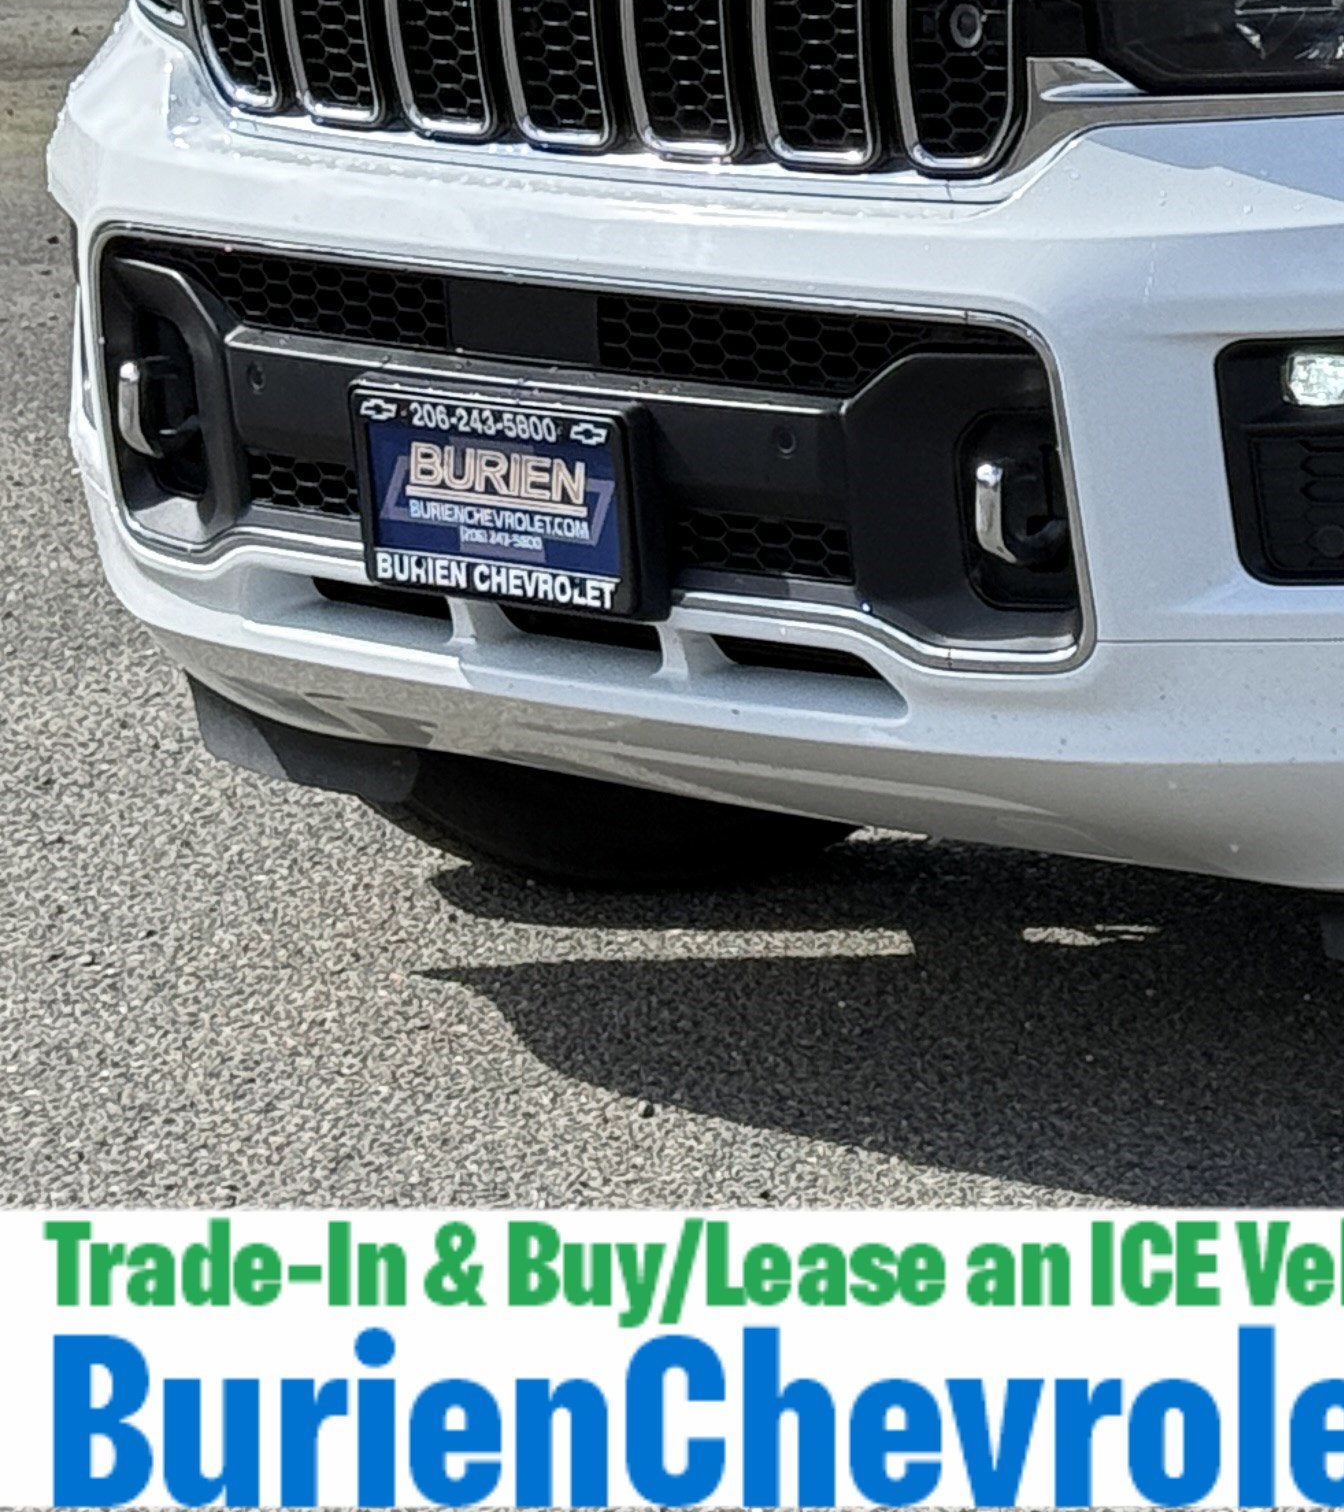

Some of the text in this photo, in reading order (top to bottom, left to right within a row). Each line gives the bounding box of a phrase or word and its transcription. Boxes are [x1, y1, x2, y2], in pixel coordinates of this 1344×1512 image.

[409, 401, 558, 443] 206-243-5800
[409, 440, 586, 506] BURIEN
[408, 498, 590, 541] BURIENCHEVROLET.COM
[375, 551, 617, 610] BURIEN CHEVROLET
